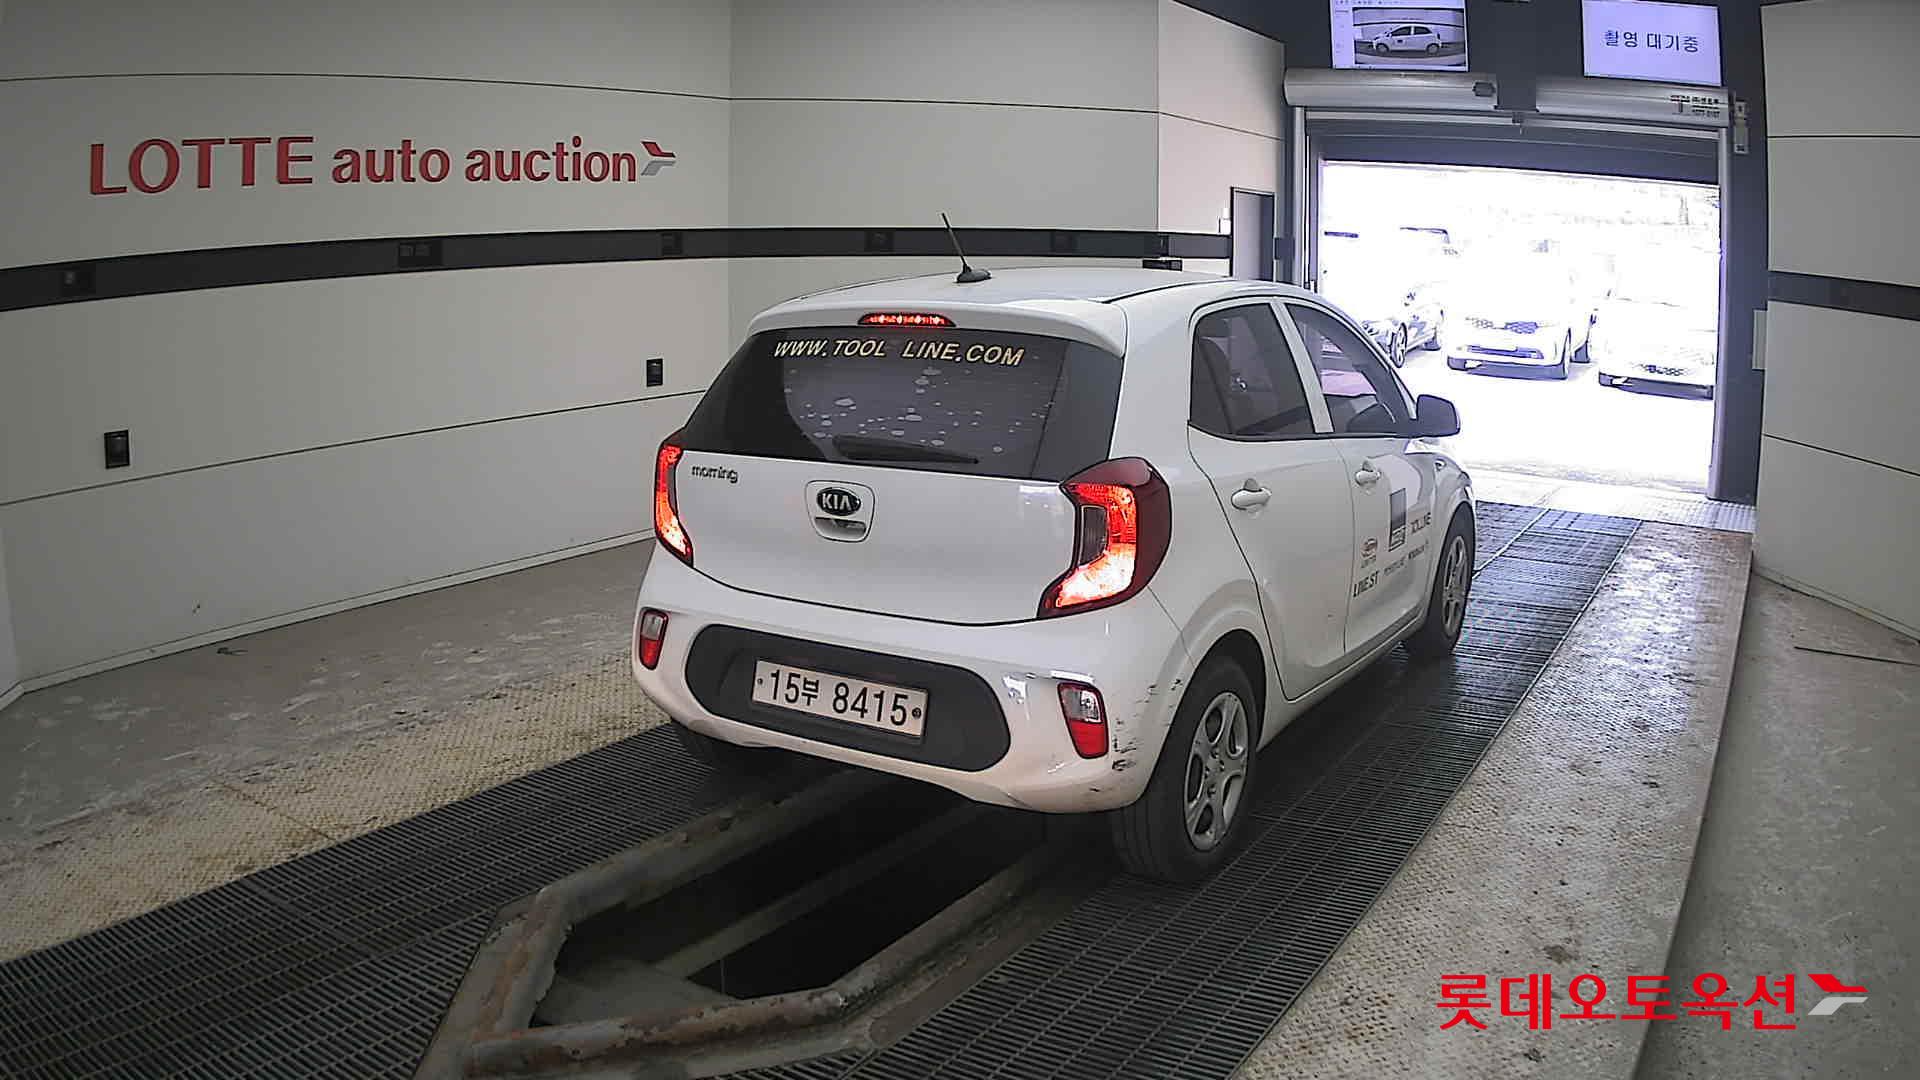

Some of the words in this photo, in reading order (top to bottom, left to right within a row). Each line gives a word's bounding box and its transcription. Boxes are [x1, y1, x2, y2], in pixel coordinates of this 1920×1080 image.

[1646, 33, 1698, 53] 대기중
[90, 136, 313, 195] LOTTE
[332, 139, 450, 183] auto
[465, 136, 637, 182] auction
[691, 465, 738, 484] morning
[822, 492, 851, 511] KIA
[770, 668, 819, 707] 15부
[832, 682, 909, 726] 8415
